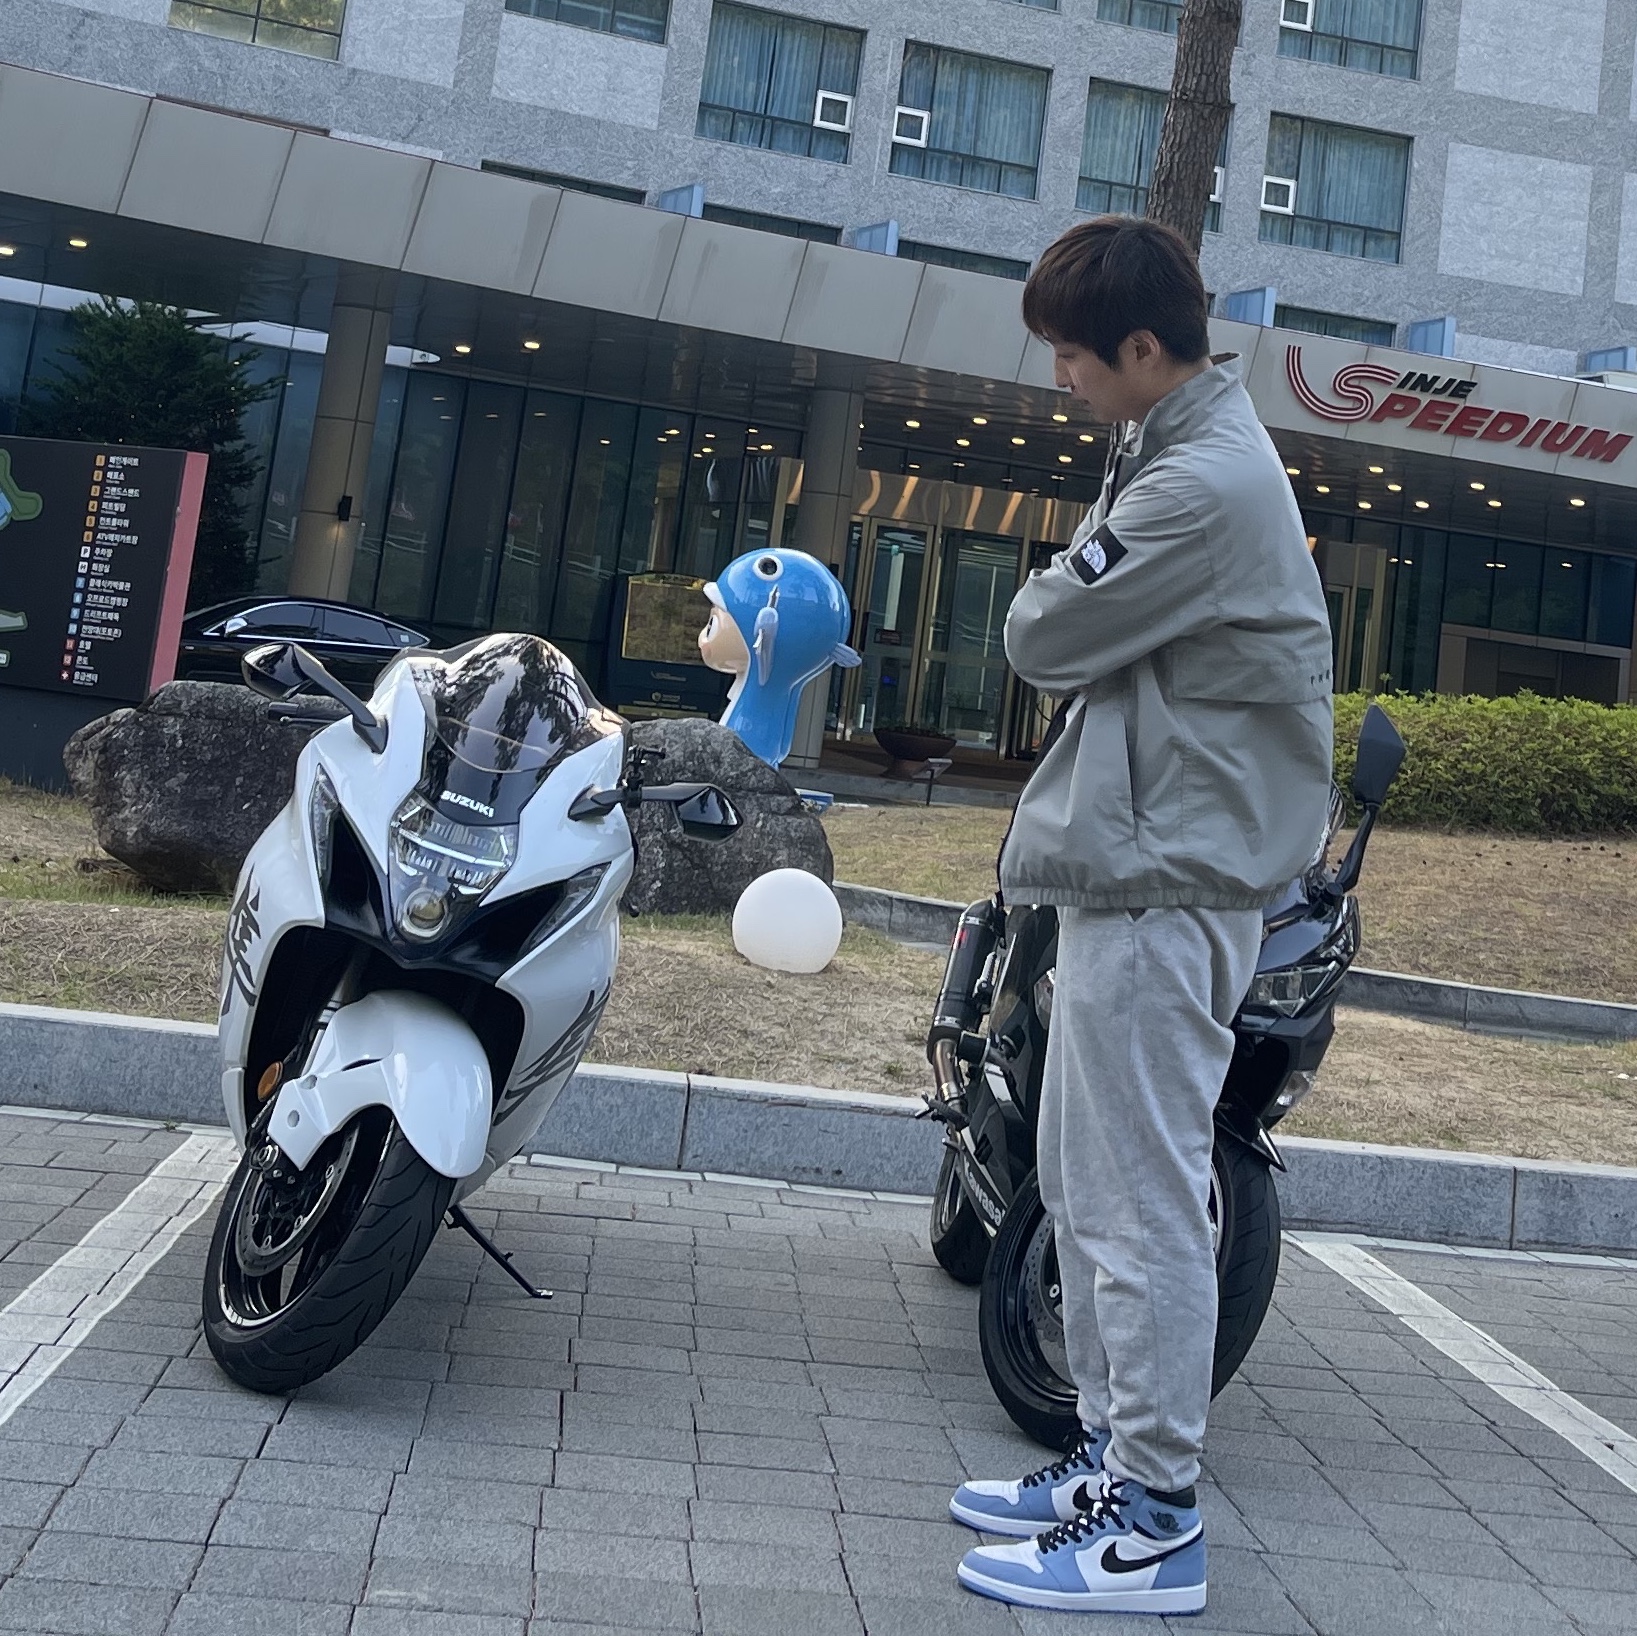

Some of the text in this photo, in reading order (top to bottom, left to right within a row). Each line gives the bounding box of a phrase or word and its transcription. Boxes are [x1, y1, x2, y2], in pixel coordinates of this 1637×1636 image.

[1396, 371, 1478, 399] INJE
[94, 547, 113, 558] 주차장
[440, 790, 495, 818] SUZUKI
